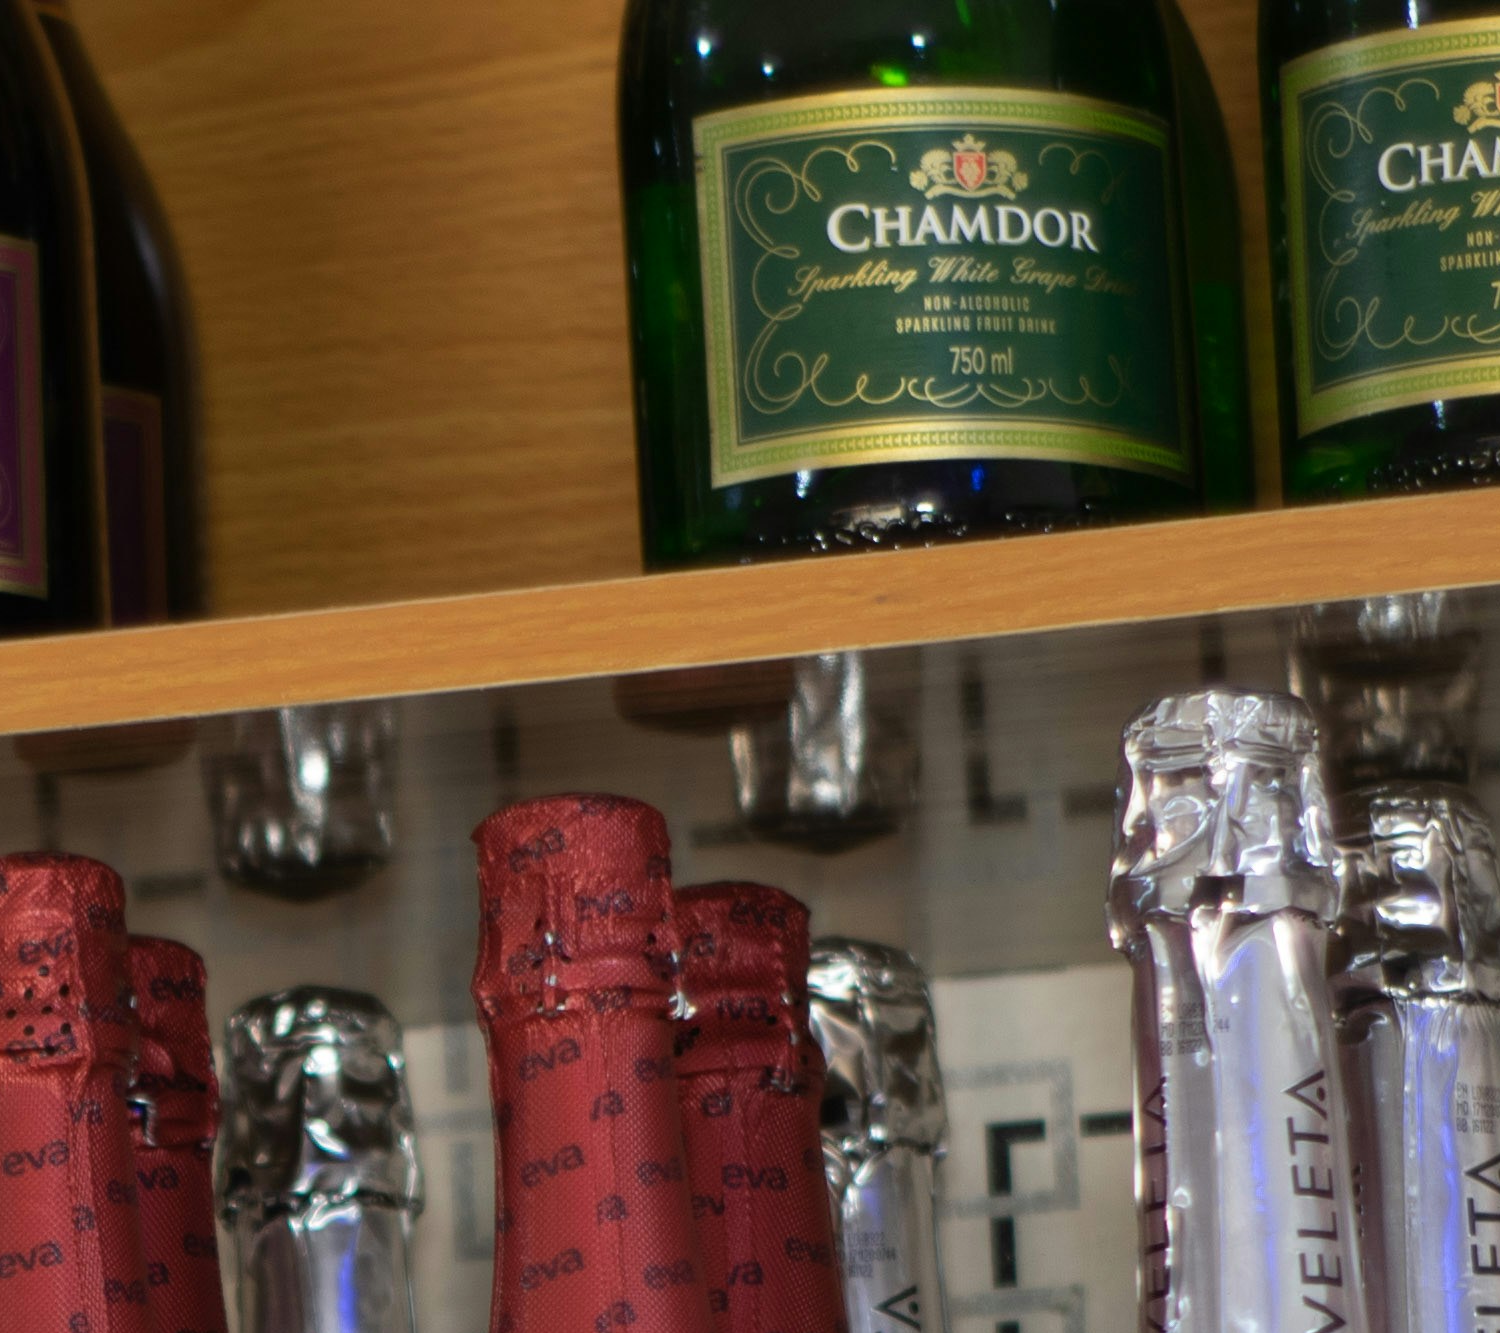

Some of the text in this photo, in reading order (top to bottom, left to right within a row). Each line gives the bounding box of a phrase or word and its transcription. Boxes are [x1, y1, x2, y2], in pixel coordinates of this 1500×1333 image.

[826, 203, 1100, 254] CHAMDOR
[1345, 197, 1461, 247] Sparkling
[924, 296, 1031, 313] NON-ALCOHOLIC
[949, 347, 1014, 375] 750 ml
[2, 1138, 71, 1176] eva
[519, 1144, 586, 1188] eva
